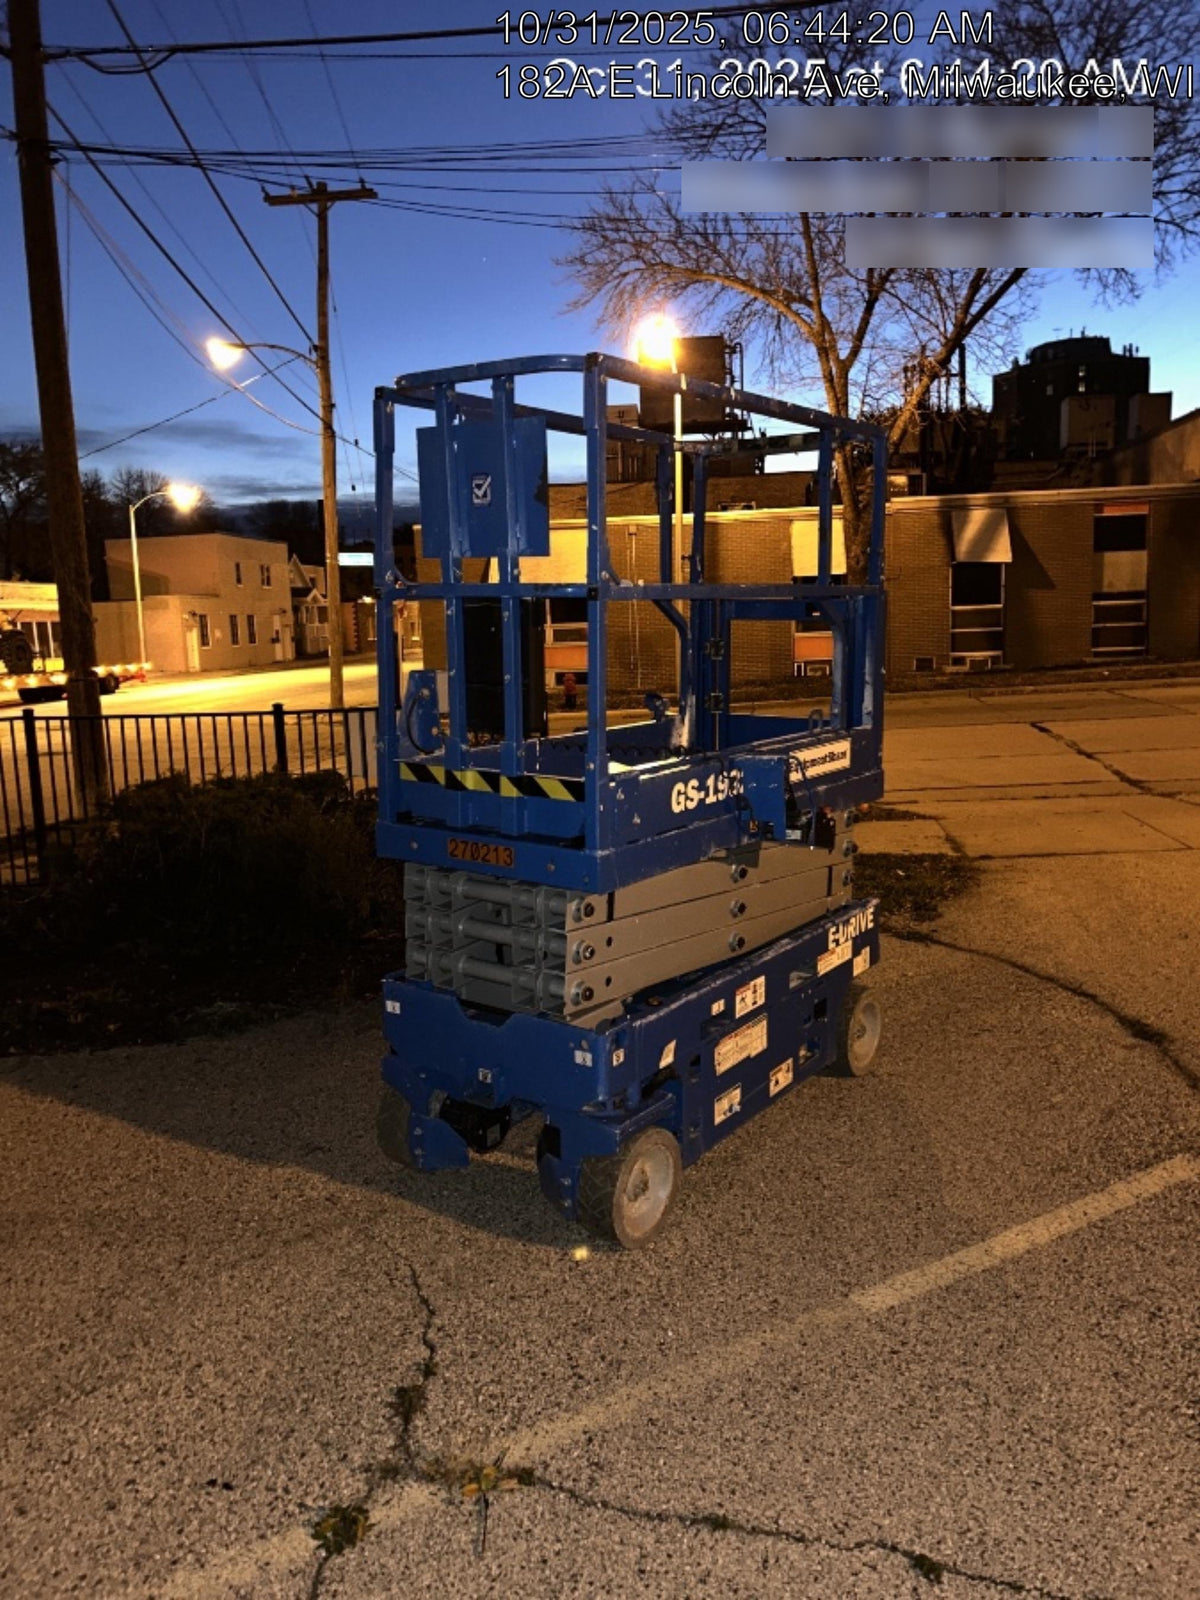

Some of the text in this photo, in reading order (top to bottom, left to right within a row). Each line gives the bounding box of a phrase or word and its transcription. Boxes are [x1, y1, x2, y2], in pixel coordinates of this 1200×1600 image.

[671, 769, 745, 813] GS-193
[448, 838, 514, 867] 270213
[828, 906, 875, 951] E-DRIVE
